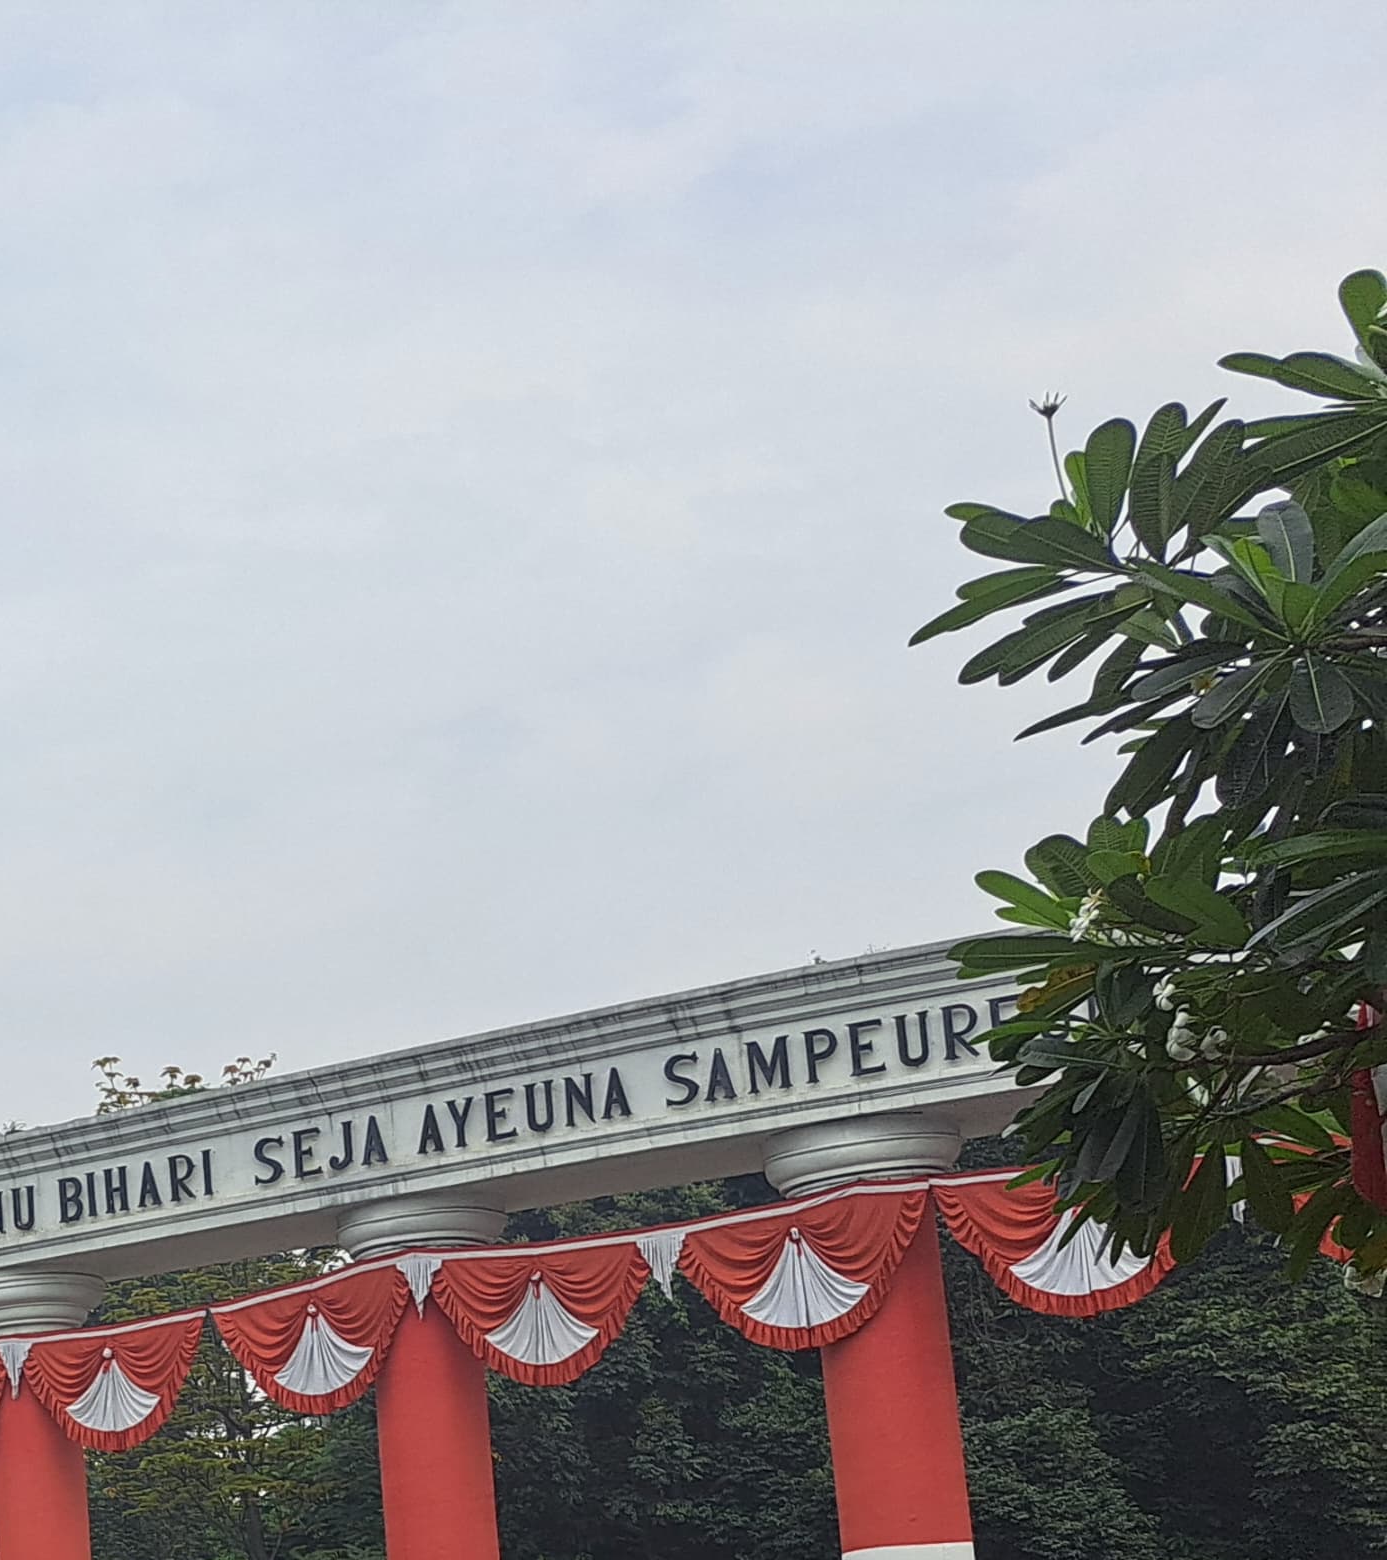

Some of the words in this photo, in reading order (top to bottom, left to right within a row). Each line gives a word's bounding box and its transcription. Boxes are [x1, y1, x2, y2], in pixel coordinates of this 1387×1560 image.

[57, 1148, 214, 1224] BIHARI
[253, 1114, 389, 1186] SEJA
[416, 1066, 633, 1155] AYEUNA
